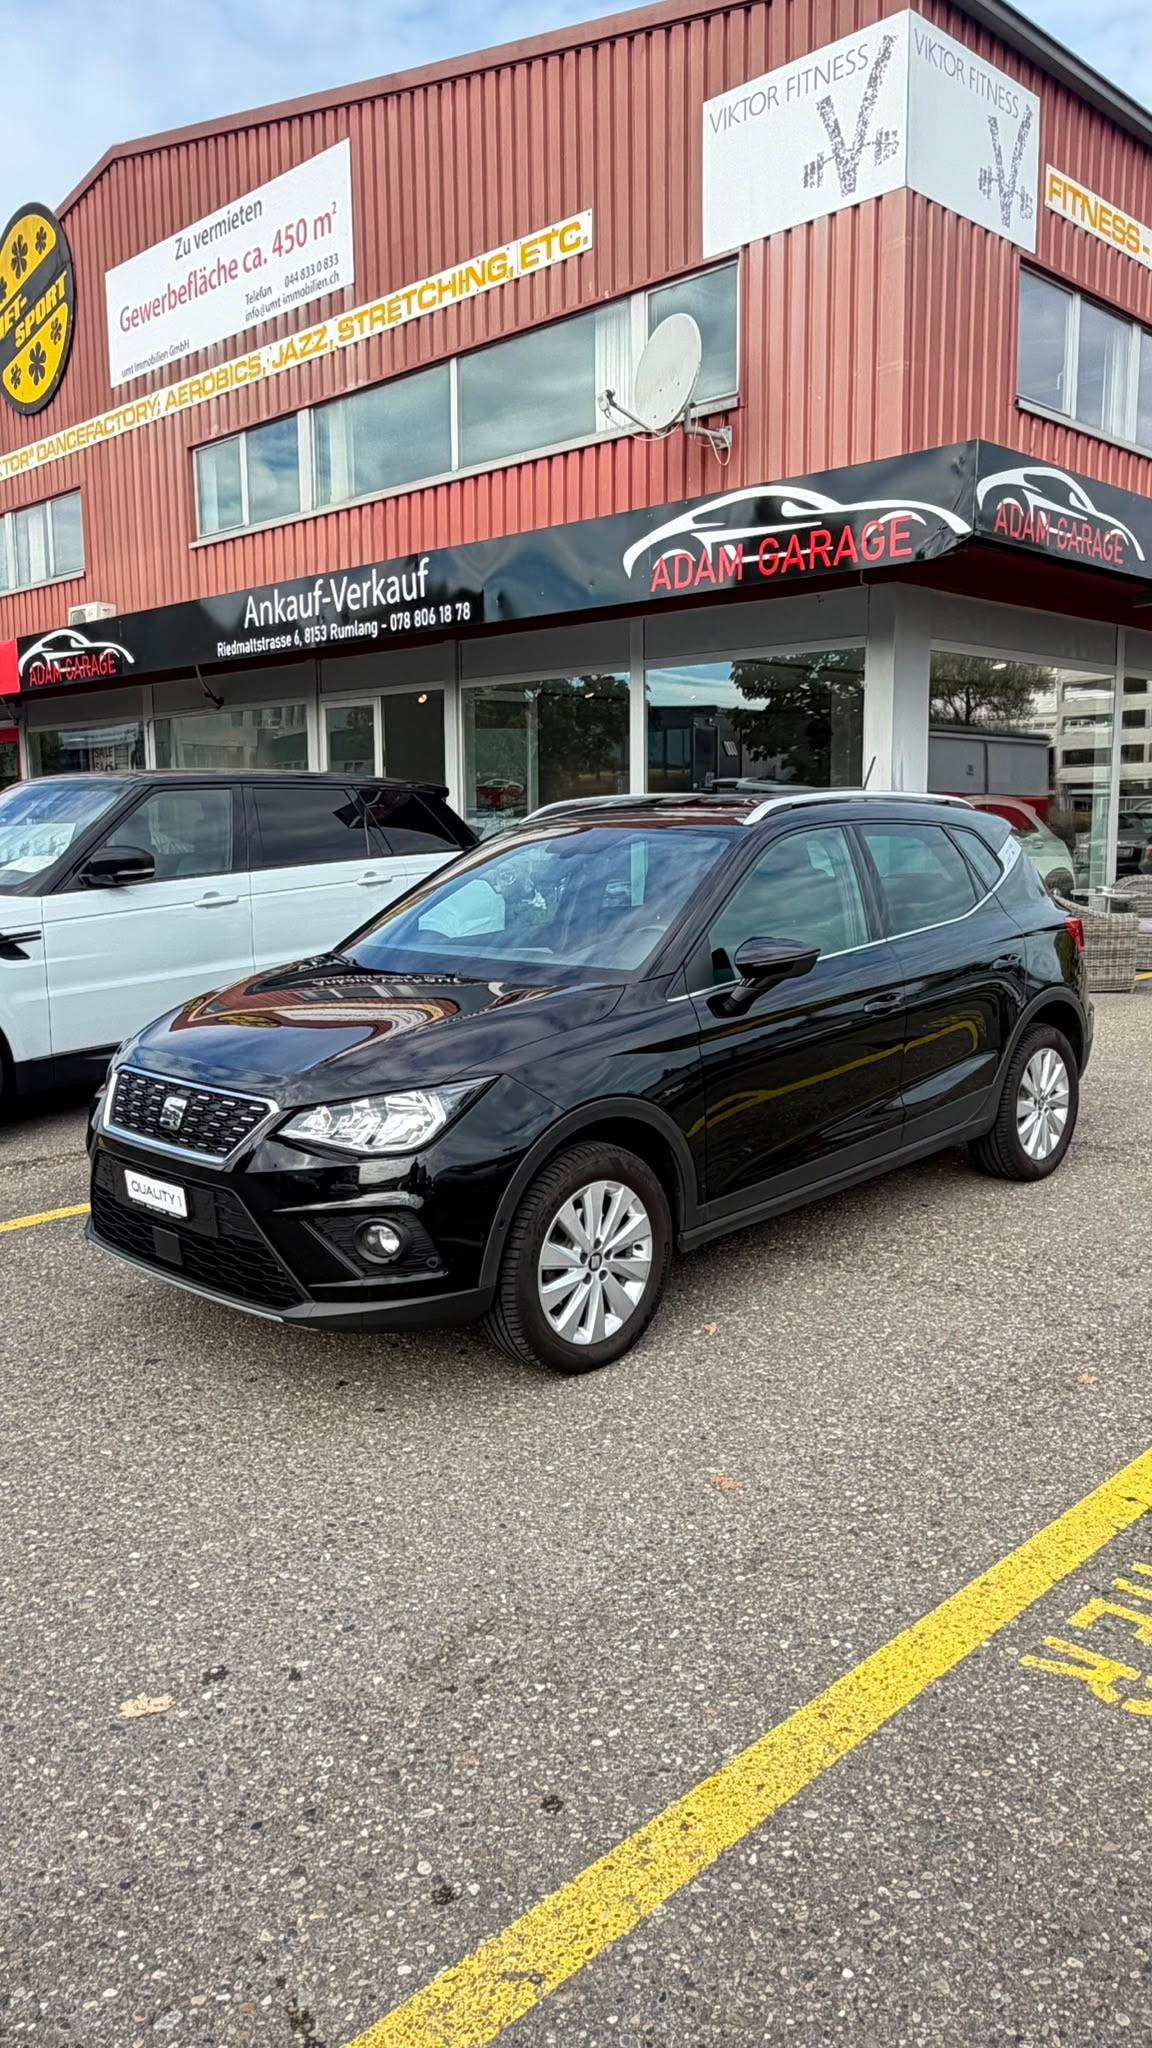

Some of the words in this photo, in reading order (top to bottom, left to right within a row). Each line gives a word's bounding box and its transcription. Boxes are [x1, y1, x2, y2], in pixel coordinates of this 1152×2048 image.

[709, 85, 778, 134] VIKTOR
[786, 43, 869, 102] FITNESS
[914, 27, 965, 83] VIKTOR
[969, 66, 1019, 120] FITNESS
[174, 236, 191, 261] Zu
[195, 200, 263, 251] vermieten
[15, 270, 67, 348] SPORT
[120, 257, 239, 333] Gewerbefläche
[242, 246, 268, 273] ca.
[271, 217, 308, 258] 450
[245, 285, 273, 305] Telefon
[284, 271, 299, 288] 044
[300, 263, 315, 281] 833
[316, 260, 322, 273] 0
[323, 252, 339, 270] 833
[165, 354, 266, 411] AEROBICS,
[272, 326, 334, 369] JAZZ,
[338, 253, 514, 343] STRETCHING,
[520, 221, 589, 269] ETC.
[169, 338, 190, 357] GmbH
[650, 542, 744, 593] ADAM
[758, 515, 913, 577] GARAGE
[994, 502, 1050, 543] ADAM
[1056, 515, 1124, 566] GARAGE
[244, 557, 429, 629] Ankauf-Verkauf
[217, 634, 292, 658] Riedmattstrasse
[293, 629, 303, 647] 6,
[304, 624, 327, 644] 8153
[330, 618, 378, 640] Rumlang
[389, 612, 411, 632] 078
[414, 607, 436, 628] 806
[440, 604, 452, 623] 18
[456, 602, 471, 621] 78
[29, 664, 62, 687] ADAM
[65, 652, 117, 681] GARAGE
